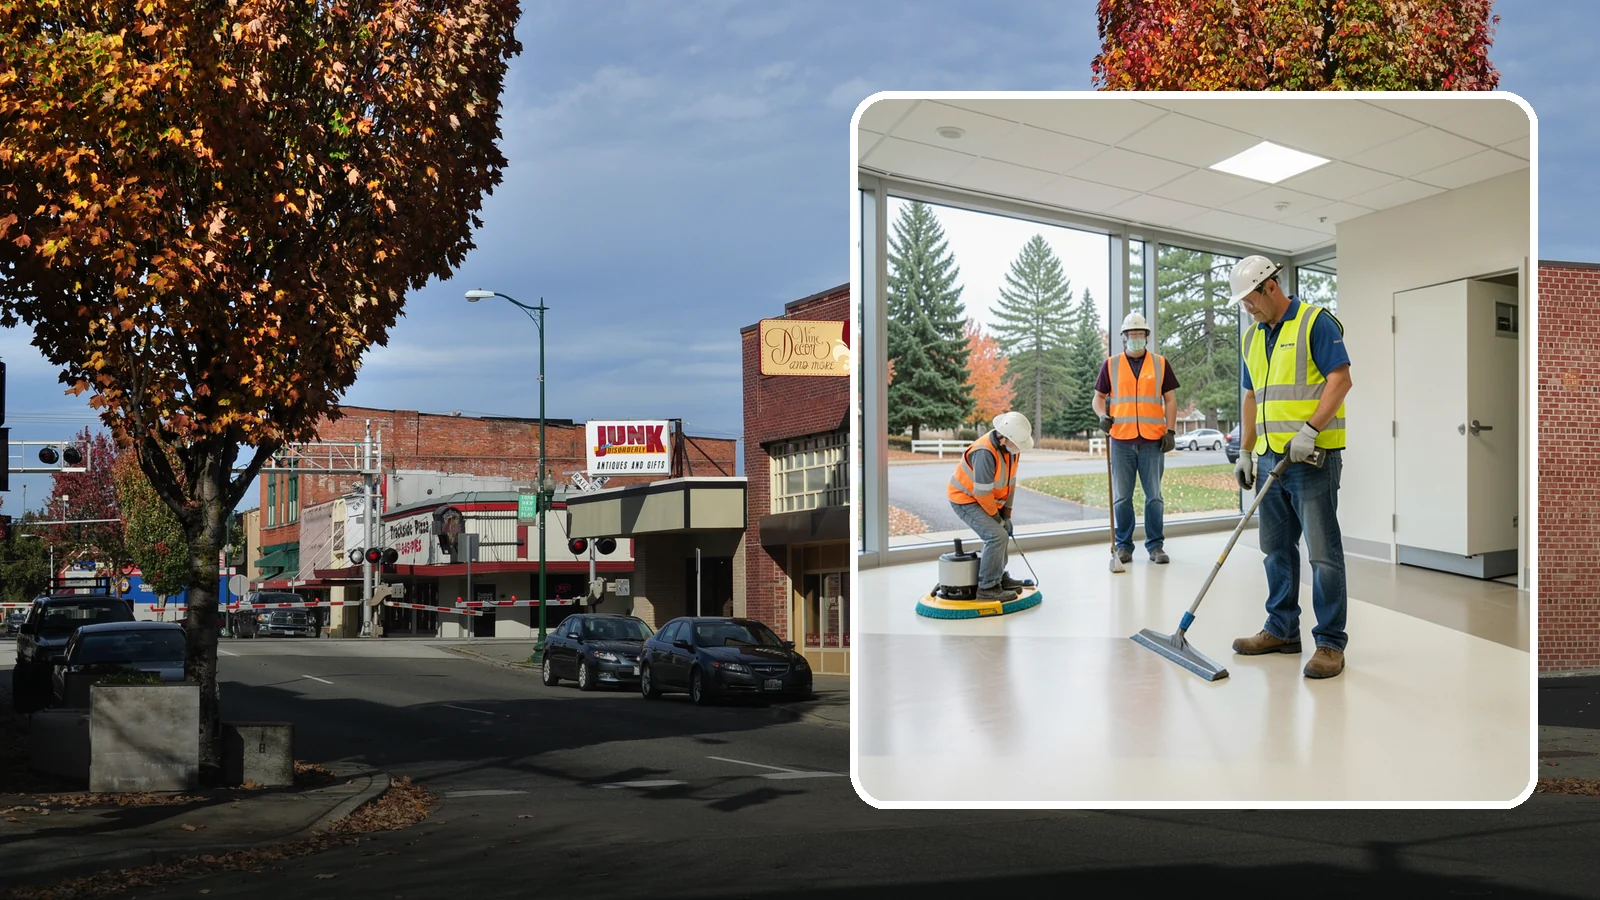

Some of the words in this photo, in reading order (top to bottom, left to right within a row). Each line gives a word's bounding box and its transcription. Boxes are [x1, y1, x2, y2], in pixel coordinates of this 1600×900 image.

[595, 425, 664, 457] JUNK
[607, 446, 645, 454] DISORDERLY
[597, 461, 627, 470] ANTIQUES
[631, 461, 643, 469] AND
[647, 460, 665, 469] GIFTS
[390, 522, 413, 539] Trackside
[415, 519, 429, 534] Pizza
